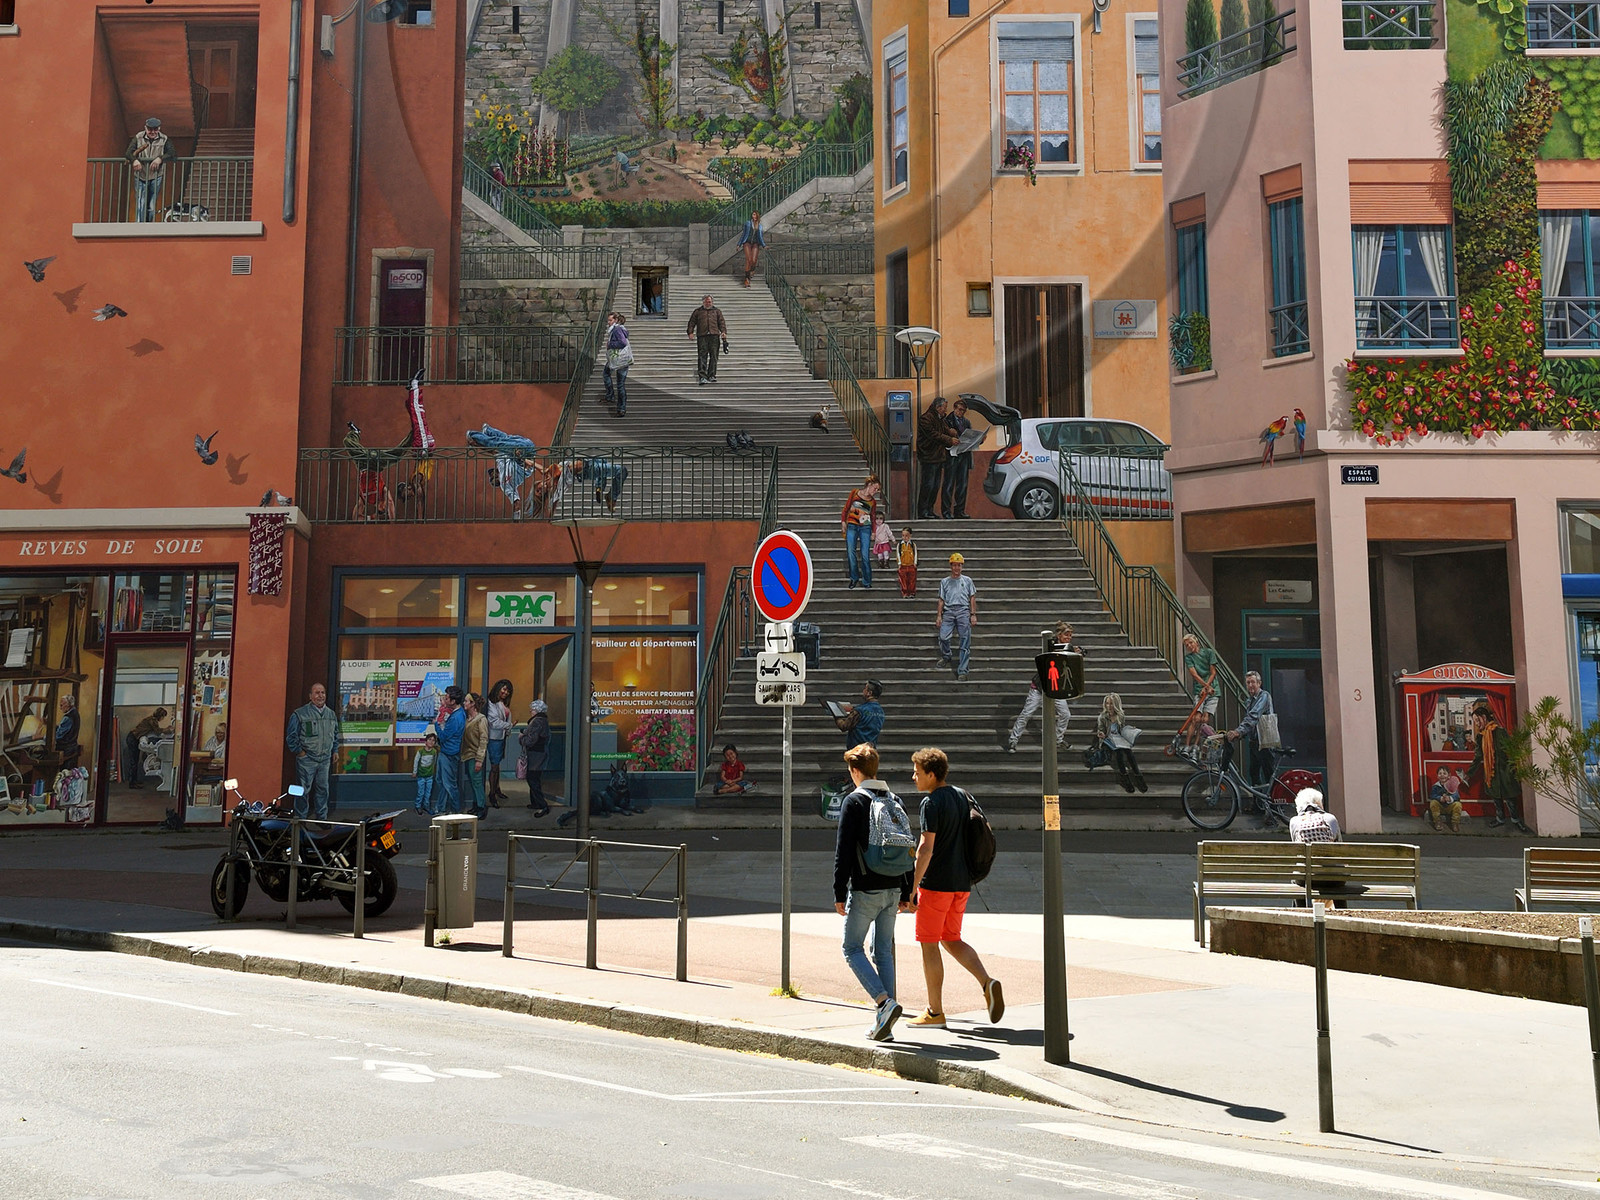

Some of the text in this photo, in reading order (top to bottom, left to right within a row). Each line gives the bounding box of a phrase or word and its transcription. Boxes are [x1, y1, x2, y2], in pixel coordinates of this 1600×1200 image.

[19, 539, 204, 556] REVES DE SOIE
[642, 640, 696, 648] département
[1433, 666, 1490, 680] GUIGNOL
[1354, 688, 1362, 701] 3
